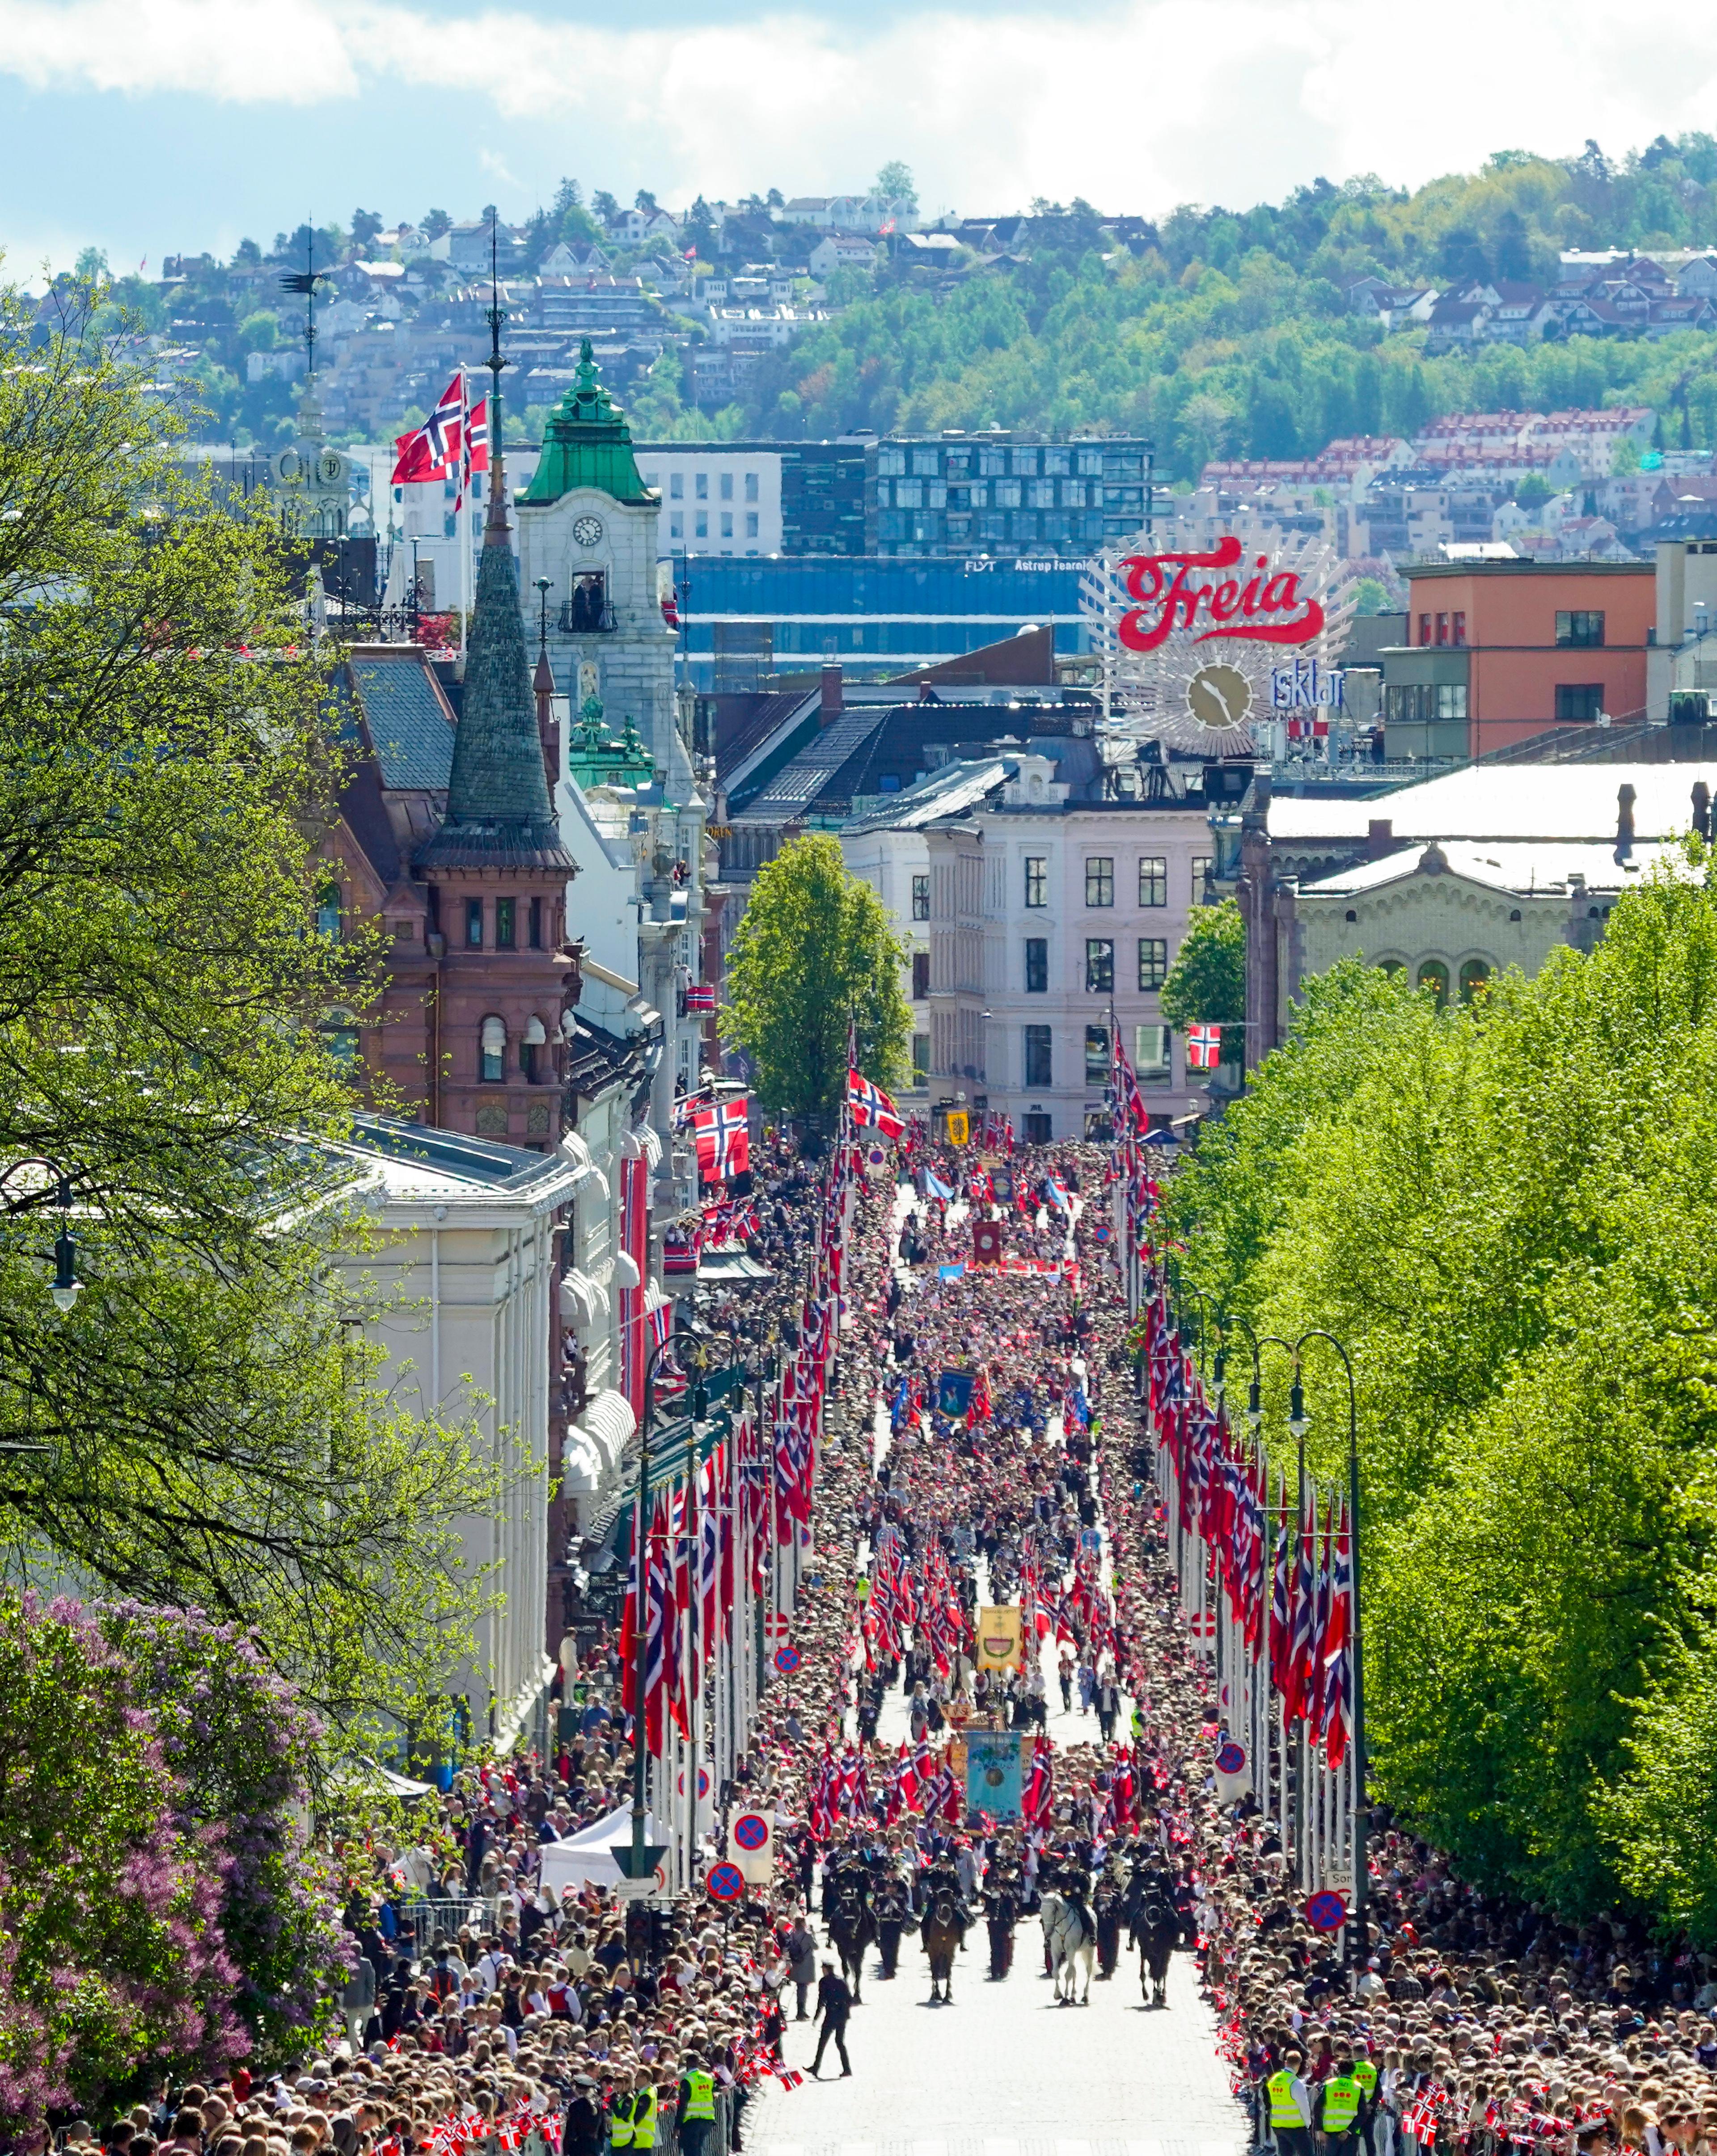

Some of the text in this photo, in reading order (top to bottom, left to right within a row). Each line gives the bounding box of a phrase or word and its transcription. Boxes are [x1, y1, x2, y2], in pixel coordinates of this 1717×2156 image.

[965, 561, 997, 572] FLYT
[1015, 559, 1051, 573] Astrup
[1119, 536, 1324, 652] Freia
[1333, 1874, 1353, 1883] Son
